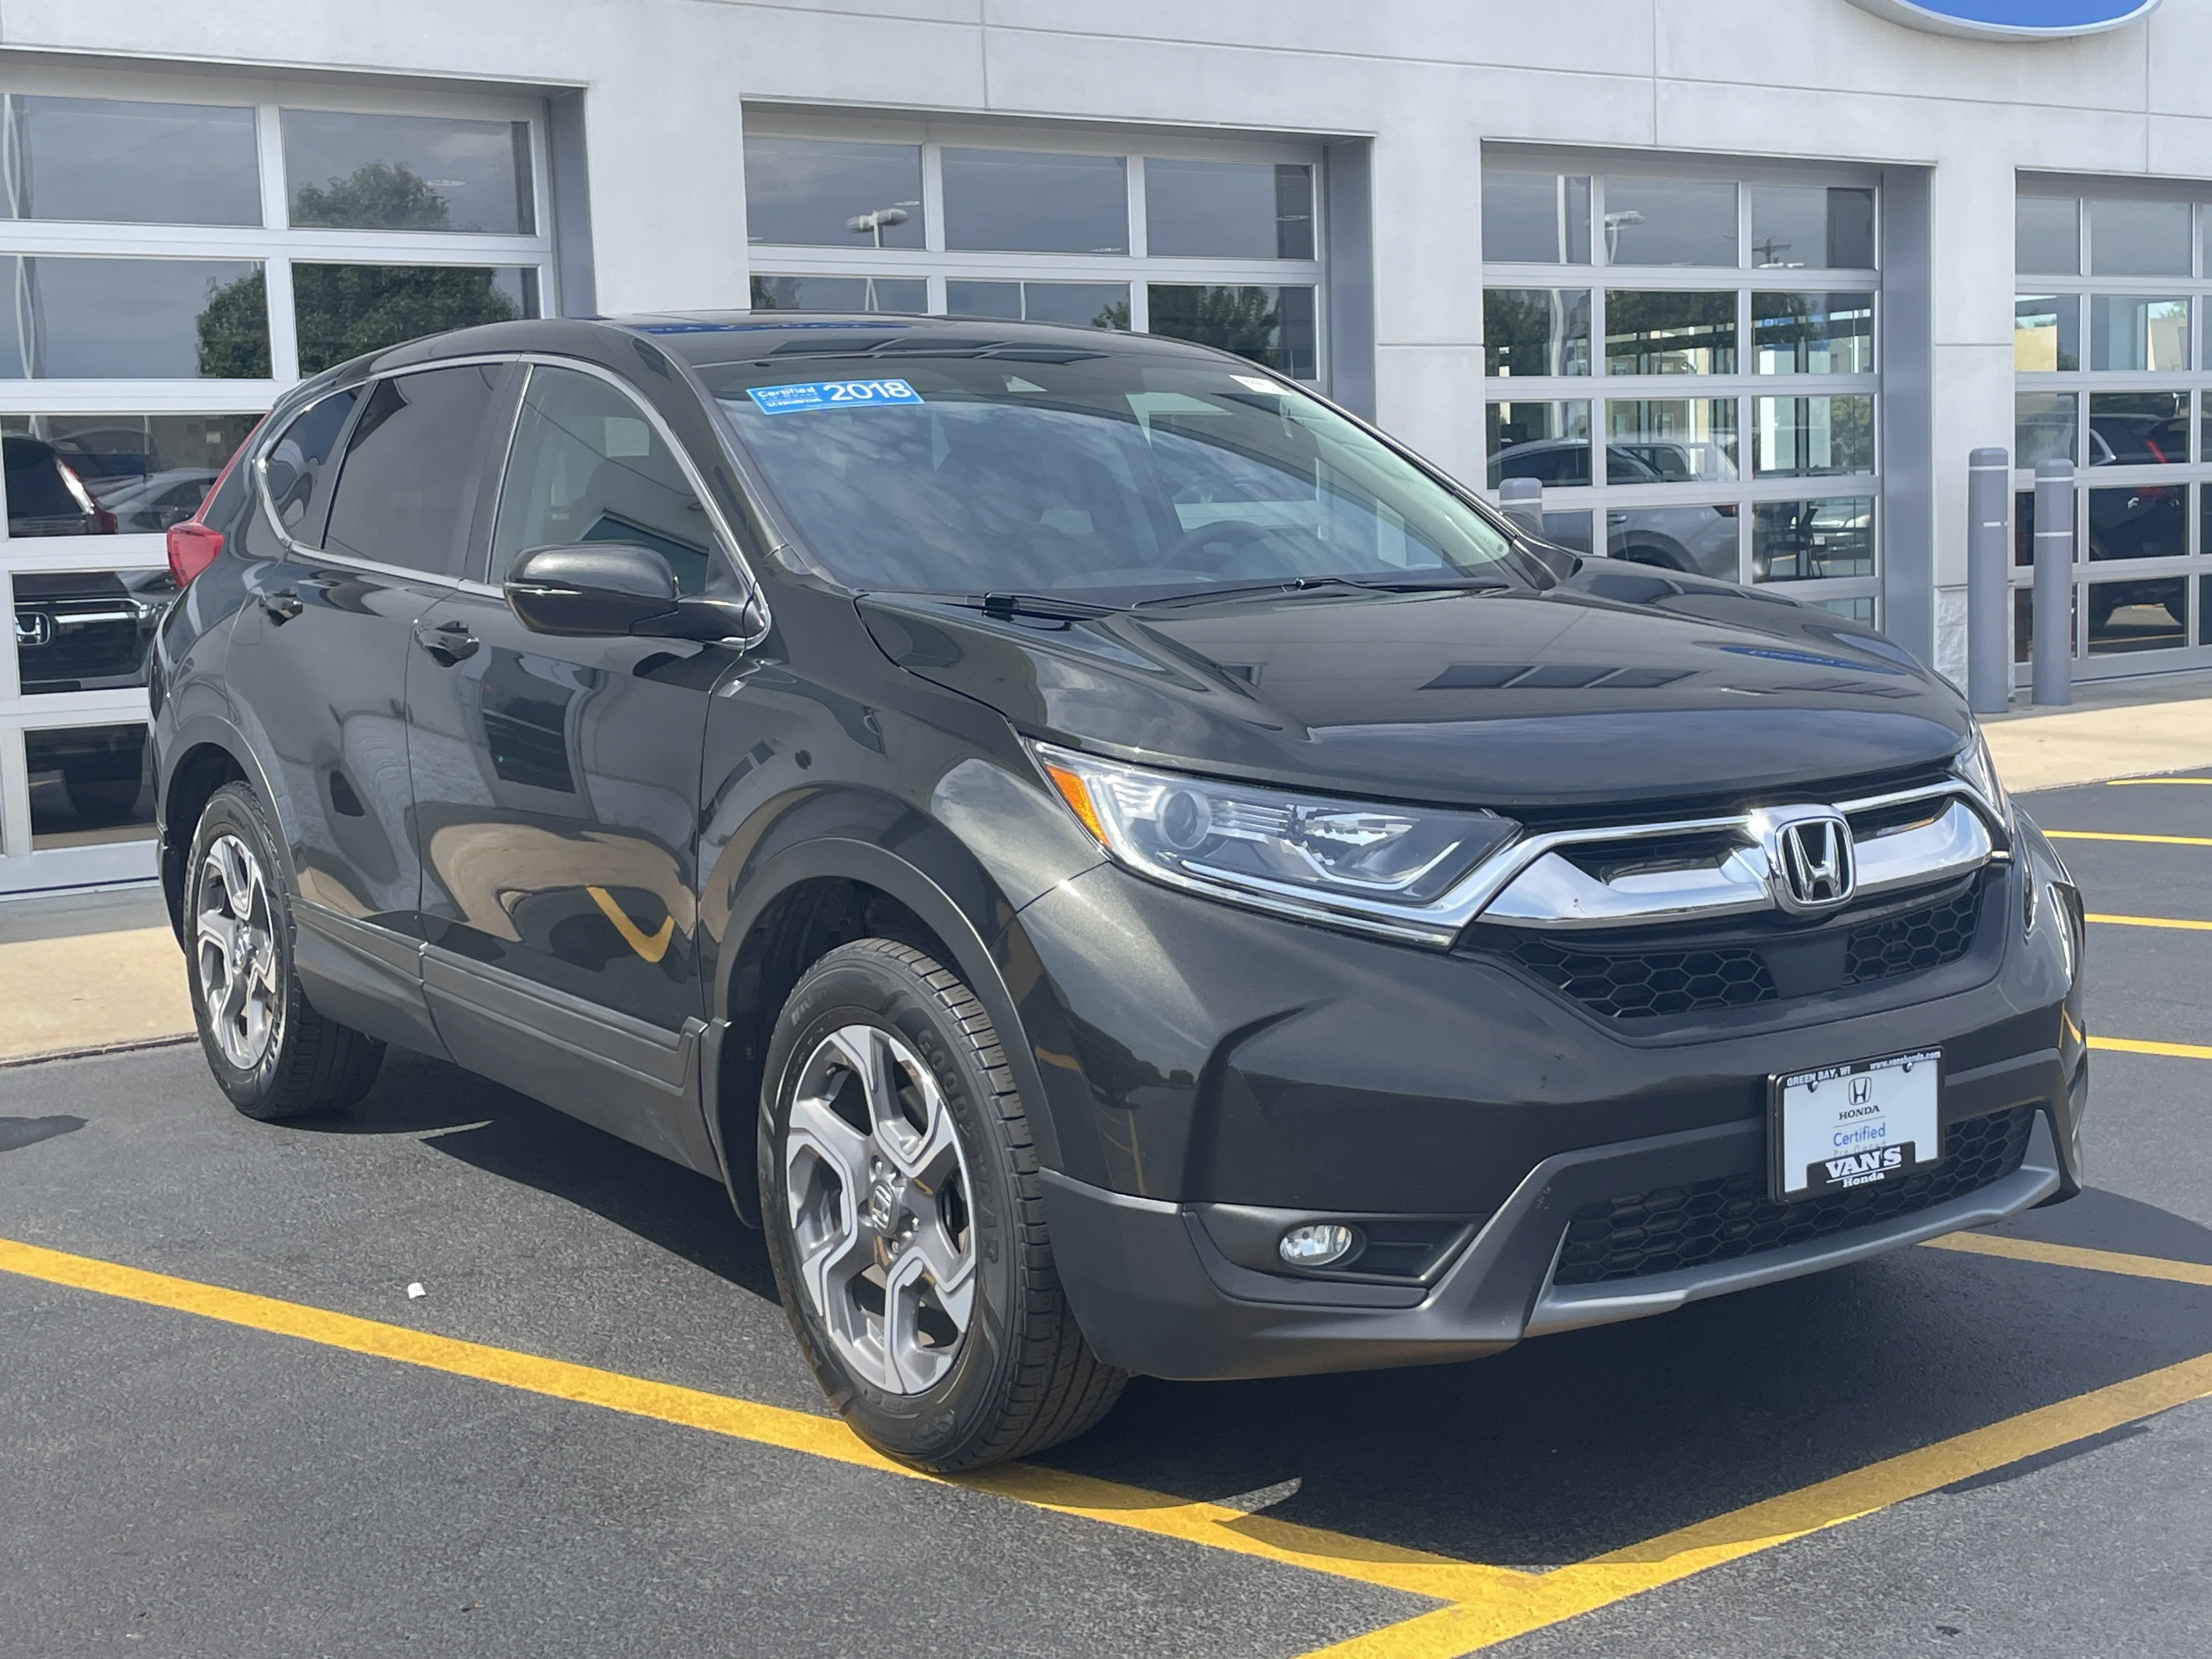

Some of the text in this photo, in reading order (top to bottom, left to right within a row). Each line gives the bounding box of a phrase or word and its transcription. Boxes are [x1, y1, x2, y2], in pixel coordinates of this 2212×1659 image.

[757, 386, 816, 397] Certified
[823, 382, 912, 401] 2018
[1787, 1072, 1816, 1087] GREEN
[1839, 1065, 1851, 1076] WI
[1838, 1104, 1881, 1120] HONDA
[1833, 1121, 1886, 1147] Certified
[1843, 1172, 1885, 1188] Honda
